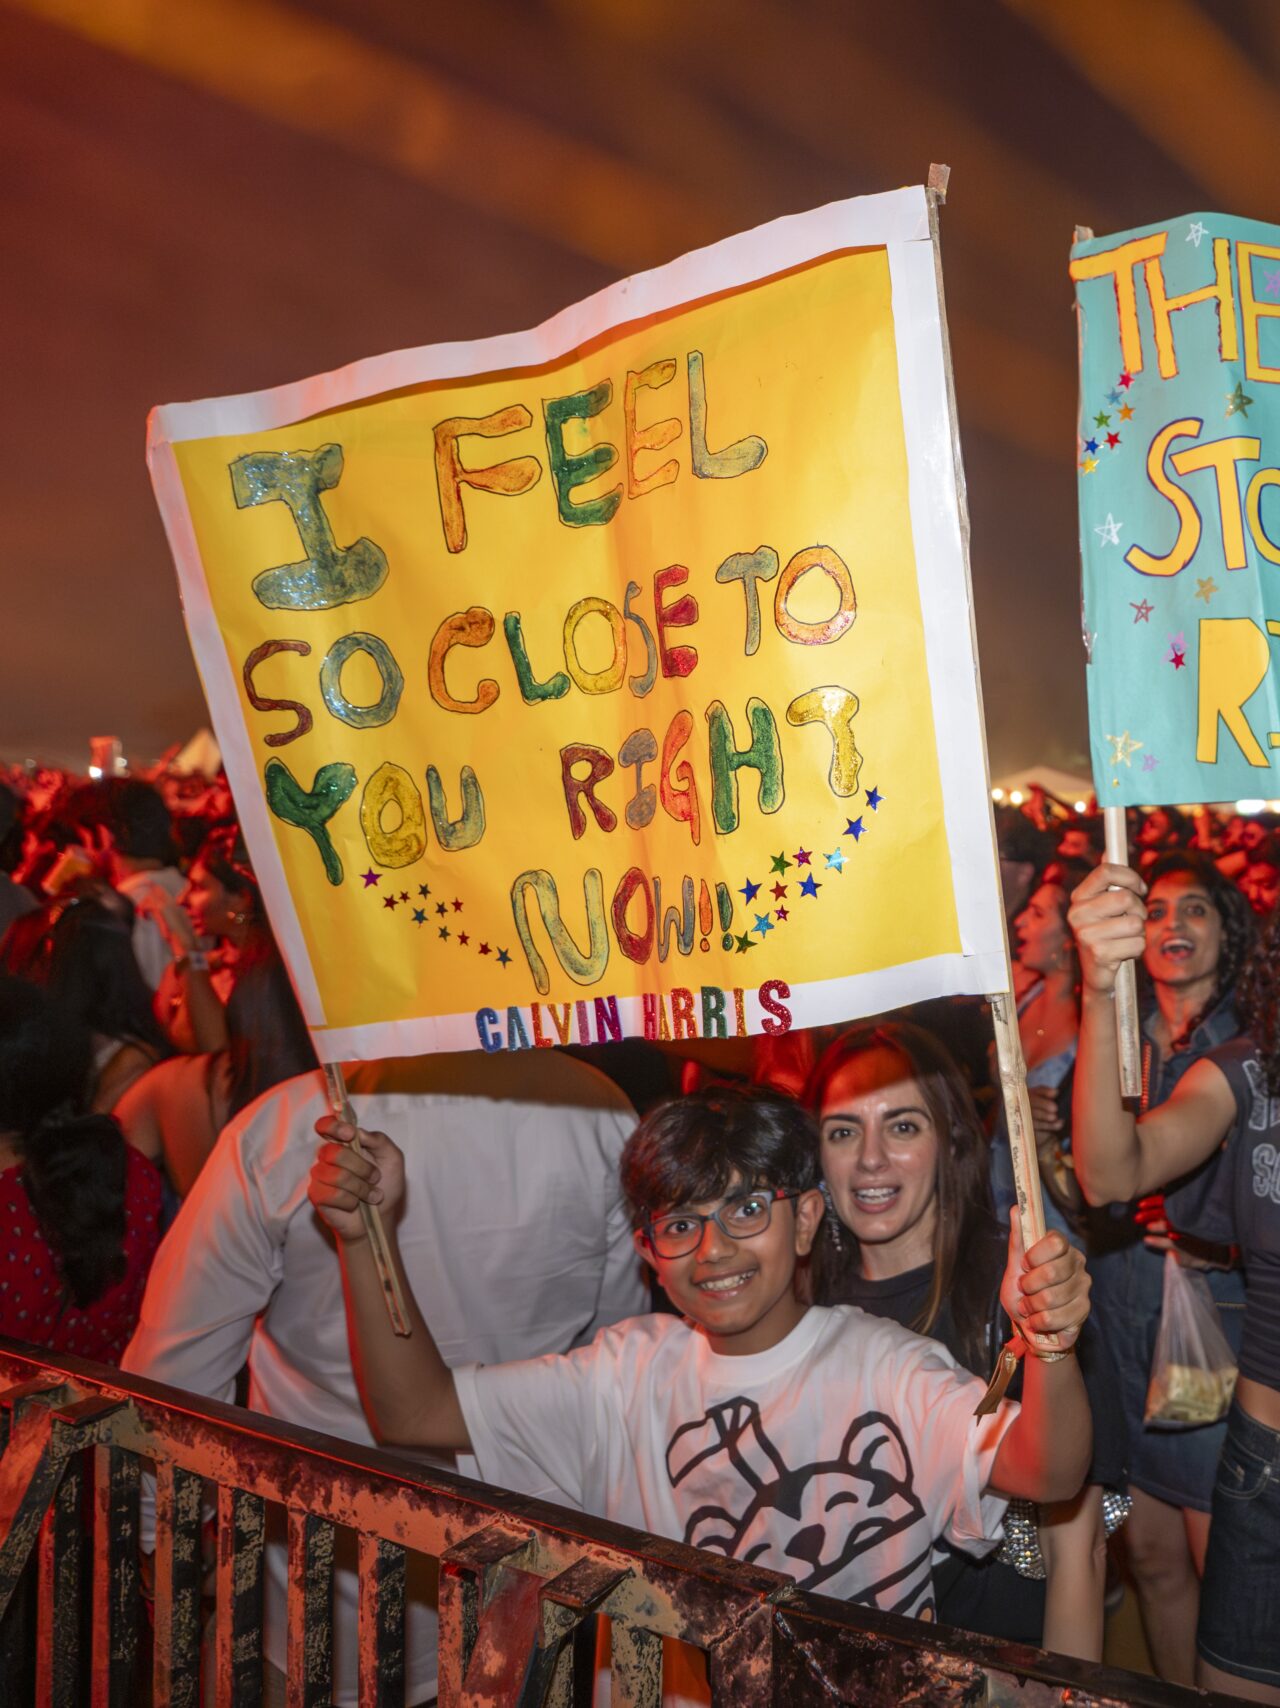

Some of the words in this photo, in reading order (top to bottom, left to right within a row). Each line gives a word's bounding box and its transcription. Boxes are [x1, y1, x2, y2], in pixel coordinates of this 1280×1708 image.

[227, 443, 388, 611] I
[433, 350, 768, 553] FEEL
[243, 631, 404, 747] SO
[428, 564, 698, 714] CLOSE
[715, 543, 857, 656] TO
[265, 757, 485, 886] YOU
[559, 685, 863, 846] RIGHT
[475, 995, 624, 1053] CALVIN
[642, 979, 793, 1039] HARRIS
[511, 866, 733, 995] NOW!!
